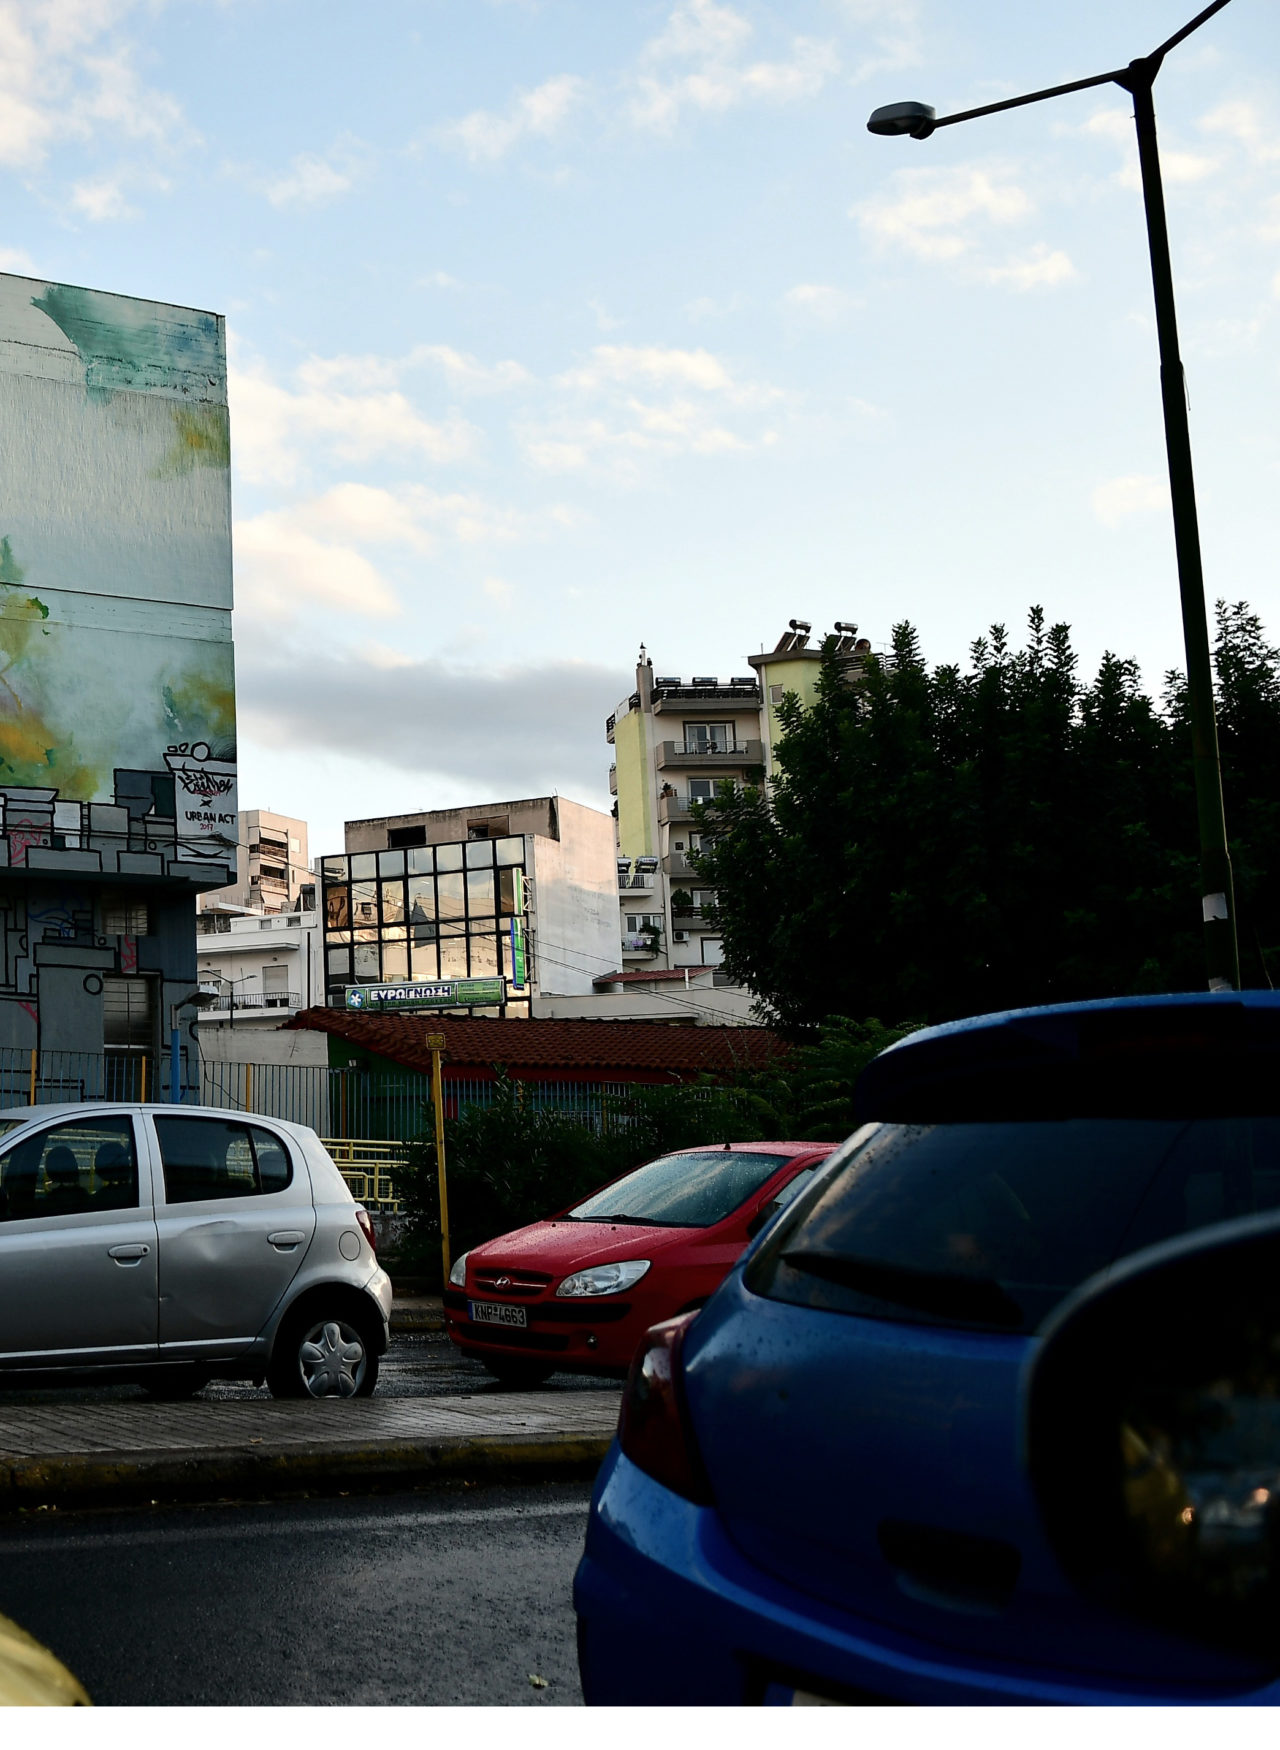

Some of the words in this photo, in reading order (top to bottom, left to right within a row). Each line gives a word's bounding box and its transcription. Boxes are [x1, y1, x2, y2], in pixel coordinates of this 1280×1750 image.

[185, 811, 216, 823] URBAN
[218, 813, 237, 825] ACT
[370, 986, 451, 1001] ΕΥΡΩΓΝΩΣΗ
